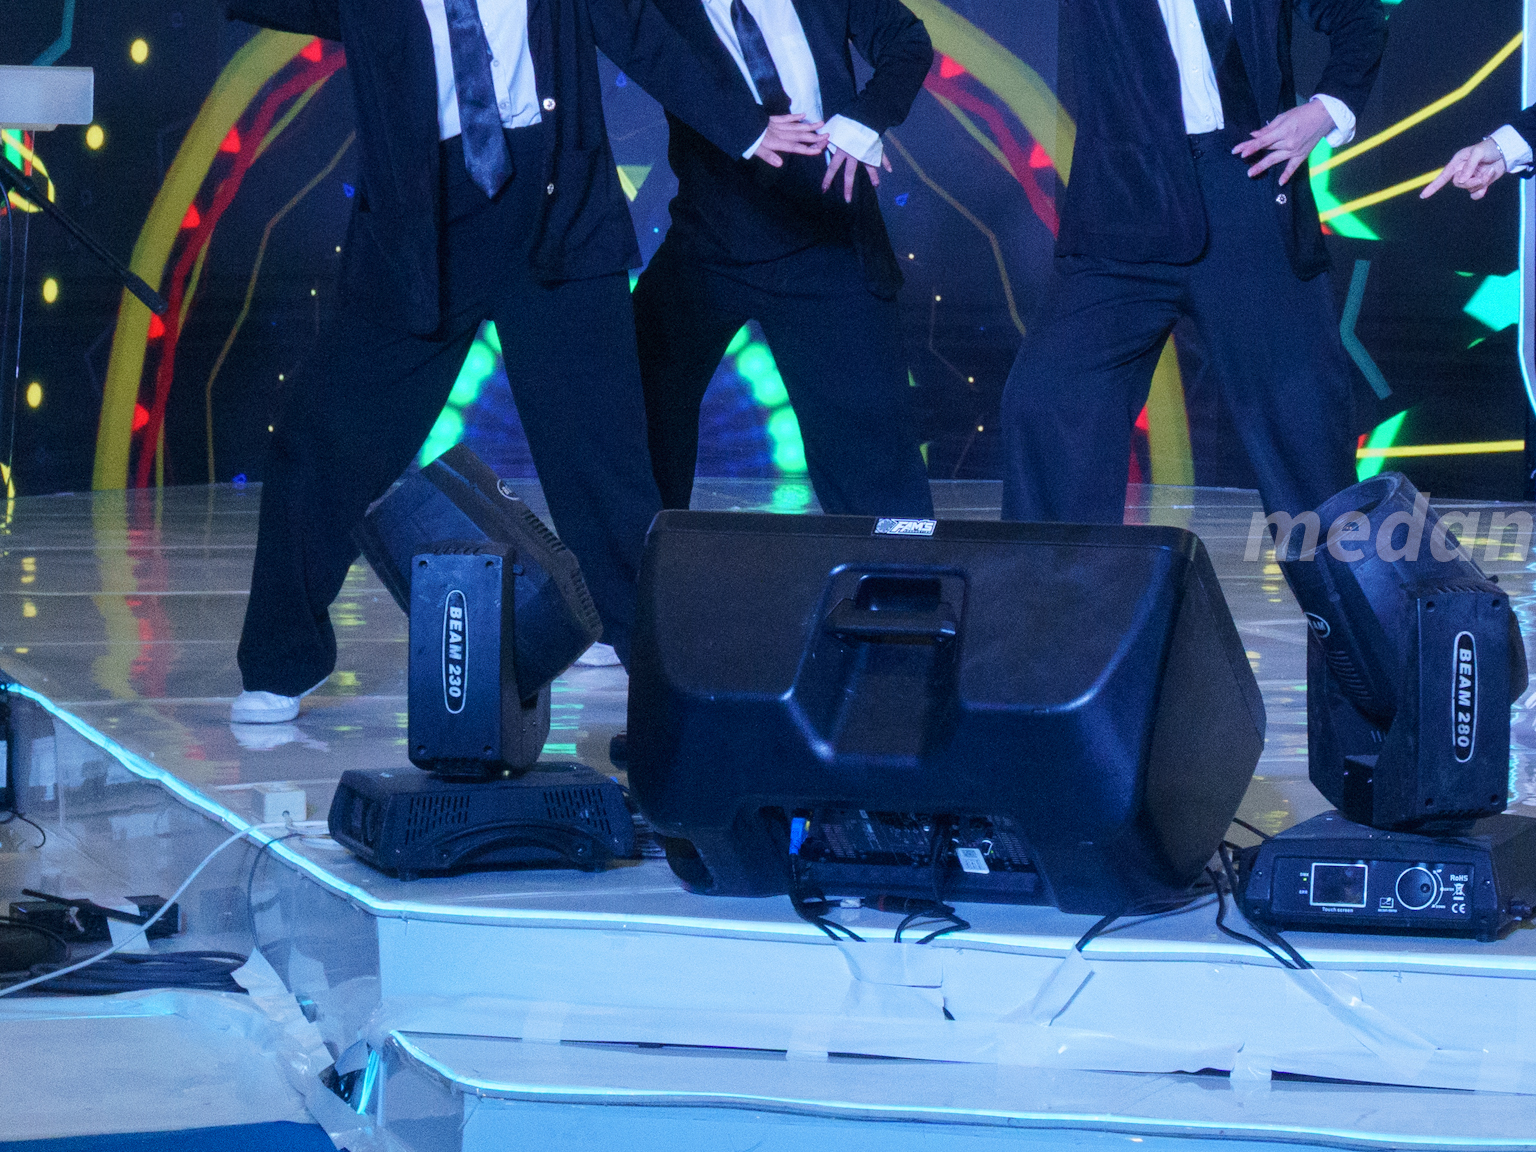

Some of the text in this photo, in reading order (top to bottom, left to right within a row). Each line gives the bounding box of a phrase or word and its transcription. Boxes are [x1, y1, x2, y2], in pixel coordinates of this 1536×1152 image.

[448, 606, 463, 698] BEAM 230
[1457, 648, 1472, 748] BEAM 280
[1449, 874, 1469, 882] RoHS
[1451, 903, 1466, 914] CE
